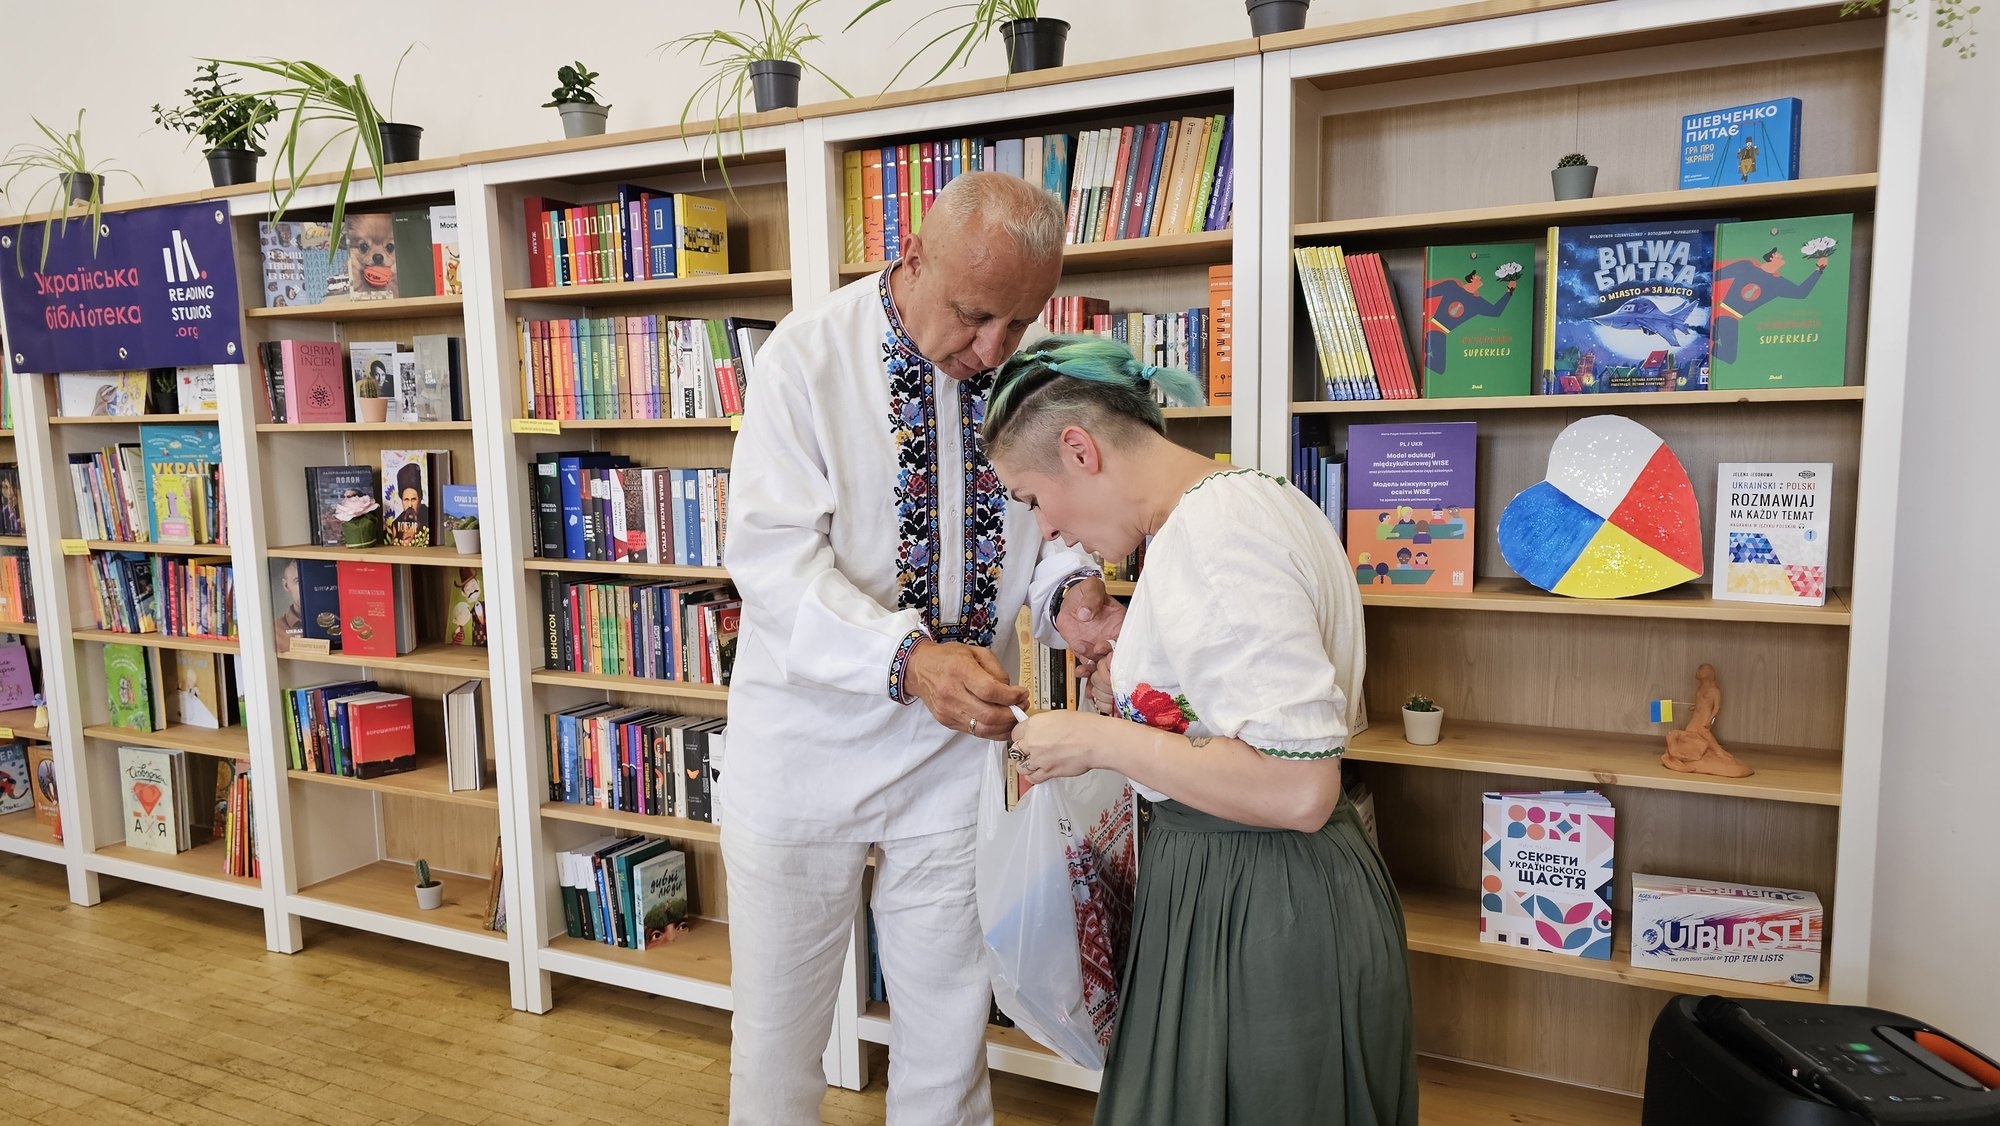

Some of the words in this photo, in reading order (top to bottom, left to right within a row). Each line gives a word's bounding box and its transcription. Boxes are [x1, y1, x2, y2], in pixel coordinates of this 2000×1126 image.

[1686, 105, 1778, 131] ШЕВЧЕНКО
[1686, 124, 1739, 143] ПИТАЄ
[1685, 146, 1698, 155] ГРА
[1700, 143, 1714, 153] ПРО
[1598, 240, 1691, 271] BITWA
[33, 266, 139, 298] Українська
[1594, 262, 1696, 291] БИТВА
[169, 284, 215, 302] READING
[1608, 287, 1641, 300] MIASTO
[1652, 286, 1662, 294] ЗА
[1664, 287, 1693, 297] МІСТО
[45, 303, 142, 330] бібліотека
[171, 304, 212, 321] STUDIOS
[175, 325, 199, 339] .org
[1759, 333, 1818, 345] SUPERKLEJ
[300, 344, 335, 356] QIRIM
[1463, 348, 1511, 357] SUPERKLEJ
[1373, 460, 1432, 468] międzykulturowej
[335, 476, 360, 484] ПОЛОН
[1399, 480, 1449, 488] міжкультурної
[1732, 480, 1776, 490] UKRAIŃSKI
[1786, 482, 1816, 490] POLSKI
[1731, 493, 1815, 507] ROZMAWIAJ
[659, 501, 667, 529] ВАСИЛЯ
[1730, 509, 1743, 519] NA
[1746, 508, 1779, 520] KAŻDY
[1782, 510, 1814, 521] TEMAT
[548, 613, 559, 660] КОЛОНІЯ
[1024, 648, 1032, 694] SAPIENS
[366, 724, 411, 736] ВОРОШИЛОВГРАД
[134, 818, 144, 834] А
[157, 822, 168, 838] Я
[1517, 850, 1579, 867] СЕКРЕТИ
[1509, 860, 1587, 877] УКРАЇНСЬКОГО
[650, 868, 679, 894] дивні
[1518, 869, 1586, 890] ЩАСТЯ
[658, 884, 683, 899] люди
[1640, 912, 1811, 952] OUTBURST!
[1724, 955, 1740, 963] TOP
[1742, 954, 1759, 962] TEN
[1760, 954, 1784, 962] LISTS
